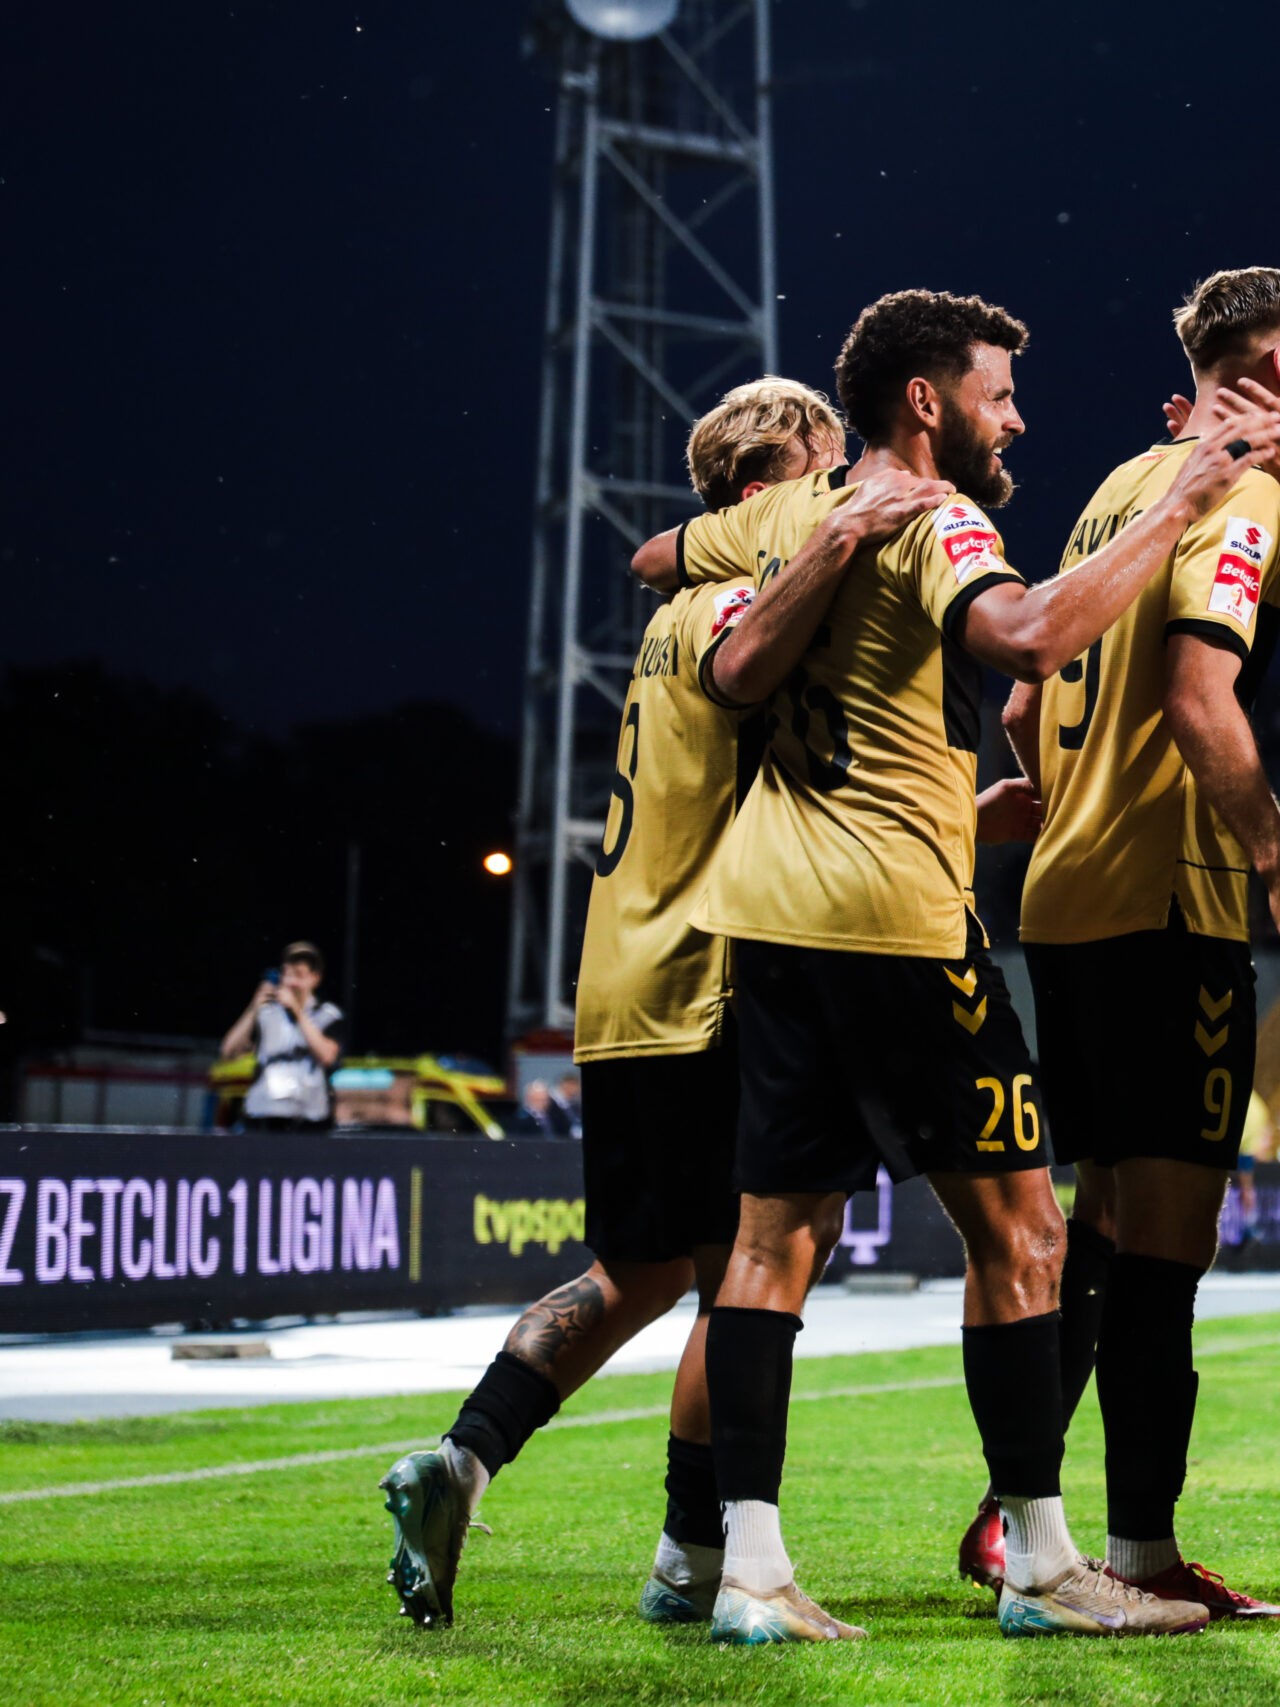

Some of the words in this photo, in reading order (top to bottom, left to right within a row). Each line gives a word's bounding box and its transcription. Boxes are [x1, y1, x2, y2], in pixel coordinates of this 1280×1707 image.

[1221, 562, 1260, 592] Betclic
[975, 1073, 1040, 1152] 26
[1200, 1067, 1232, 1142] 9
[35, 1177, 221, 1284] BETCLIC
[227, 1177, 248, 1277] 1
[257, 1177, 335, 1276] LIGI
[340, 1177, 400, 1271] NA
